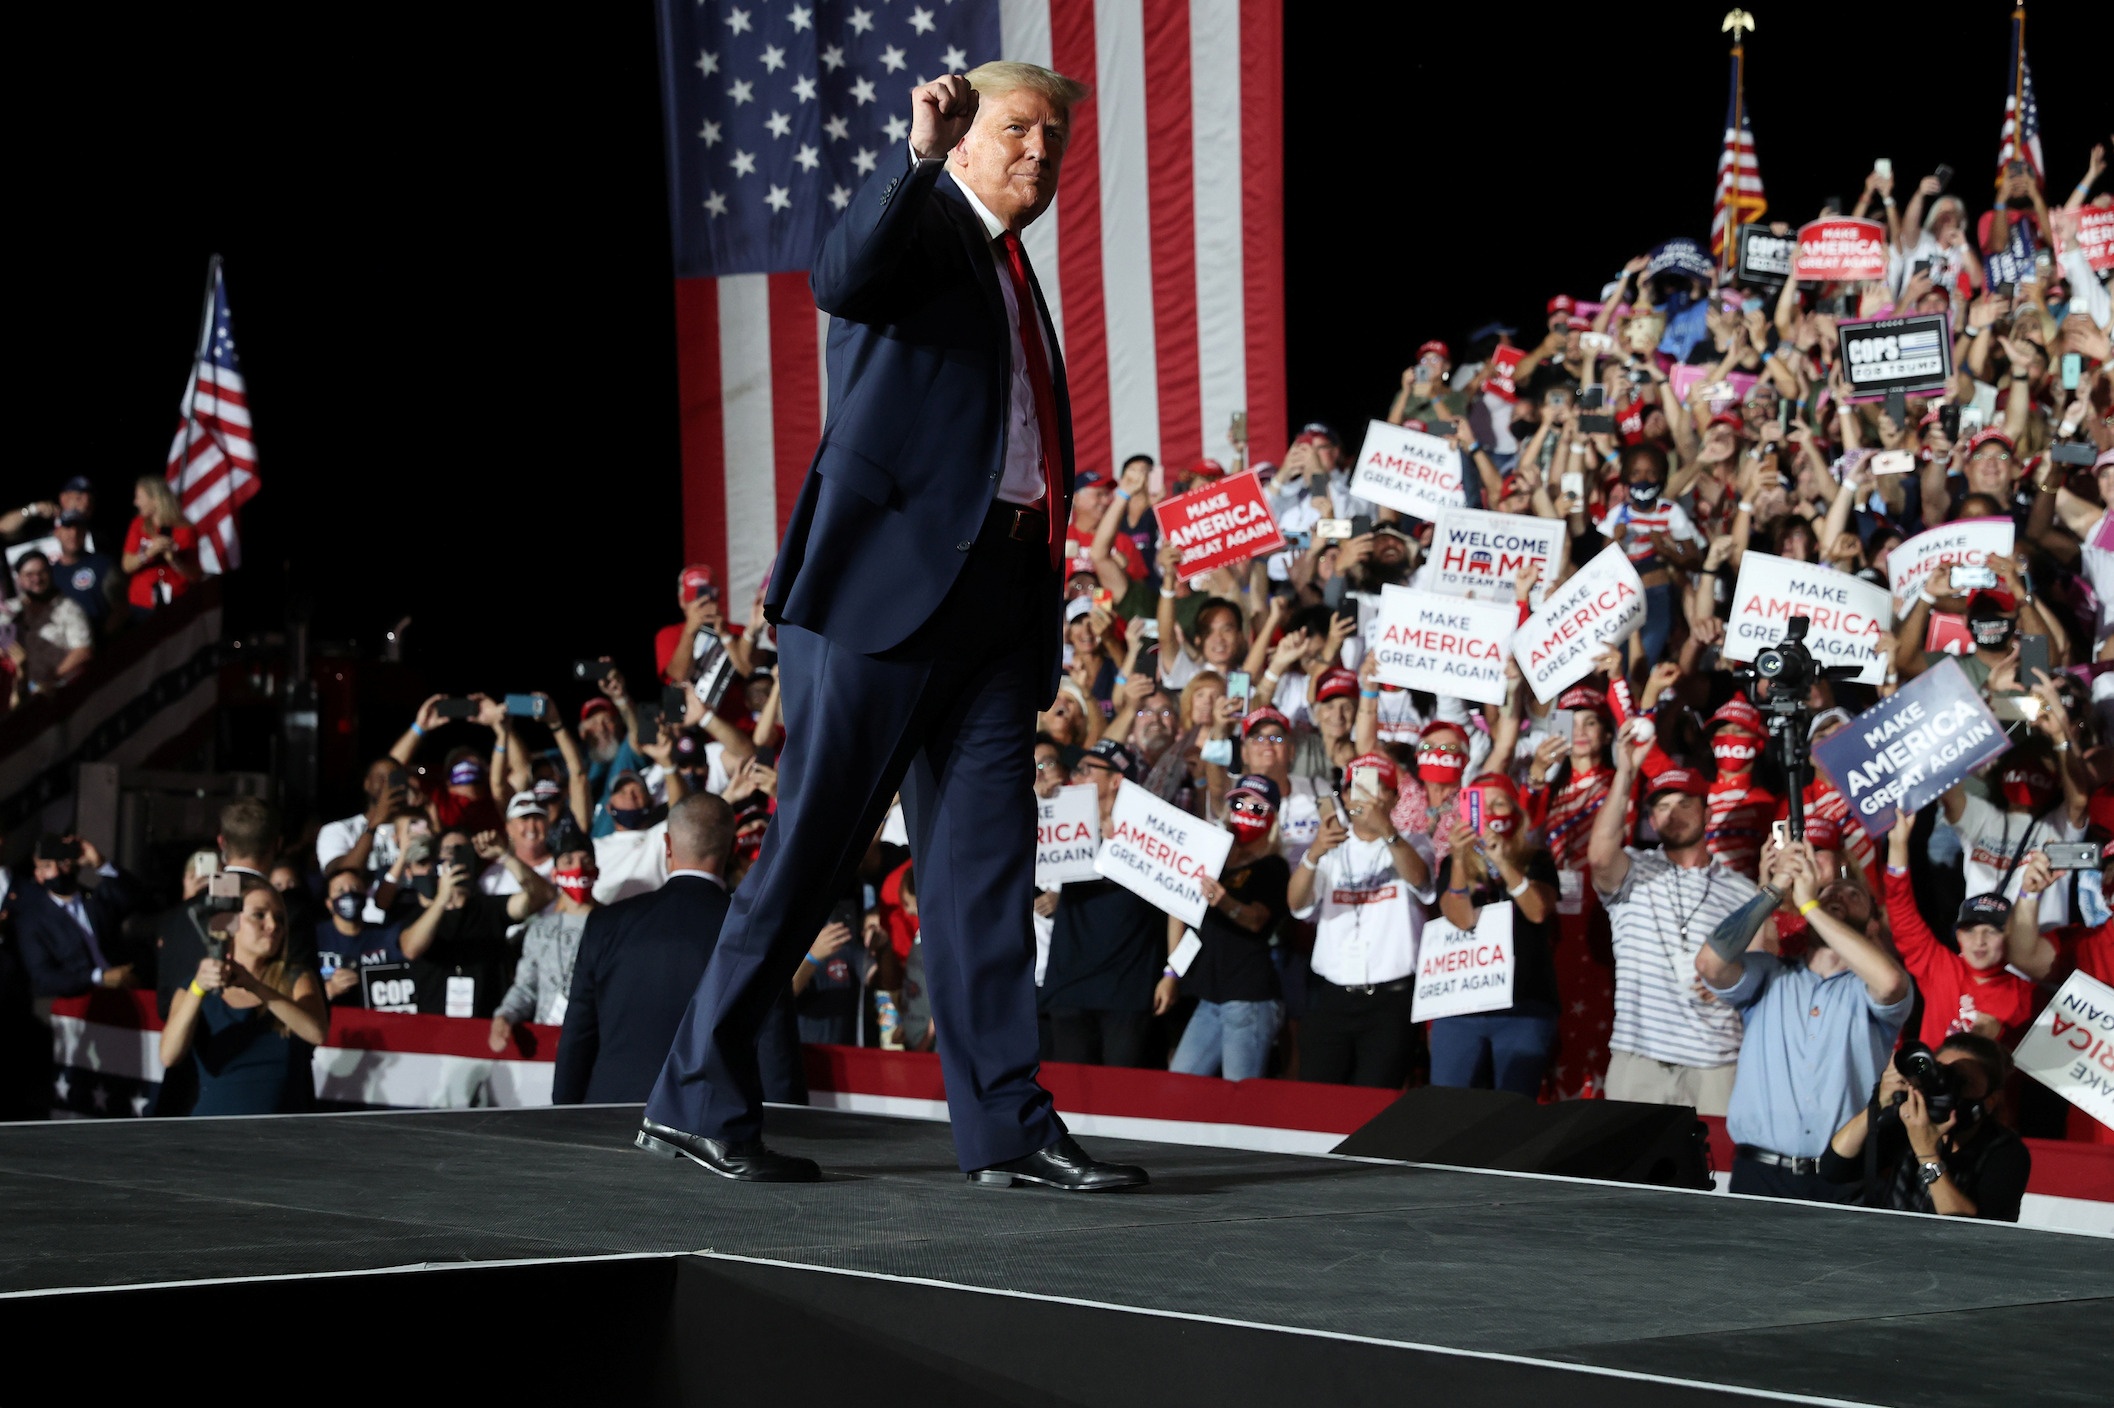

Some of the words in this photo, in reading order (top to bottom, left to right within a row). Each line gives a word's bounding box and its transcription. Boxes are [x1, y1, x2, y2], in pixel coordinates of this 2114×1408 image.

[1802, 239, 1882, 256] AMERICA
[1822, 227, 1860, 240] MAKE
[1798, 255, 1840, 269] GREAT
[1842, 254, 1884, 269] AGAIN
[1848, 335, 1899, 364] COPS
[1855, 367, 1882, 377] FOR
[1889, 361, 1938, 373] TRUMP
[1403, 444, 1446, 466] MAKE
[1363, 469, 1412, 493] GREAT
[1186, 492, 1231, 520] MAKE
[1170, 500, 1267, 548] AMERICA
[1226, 520, 1275, 548] AGAIN
[1449, 530, 1548, 554] WELCOME
[1918, 537, 1967, 555] MAKE
[1442, 573, 1458, 583] TO
[1461, 575, 1494, 586] TEAM
[1789, 580, 1848, 605] MAKE
[1419, 609, 1471, 631] MAKE
[1546, 585, 1591, 626] MAKE
[1530, 582, 1637, 669] AMERICA
[1738, 622, 1781, 643] GRE
[1813, 638, 1878, 661] AGAIN
[1383, 625, 1502, 662] AMERICA
[1536, 637, 1588, 682] GREAT
[1594, 602, 1642, 641] AGAIN
[1379, 650, 1438, 670] GREAT
[1442, 662, 1501, 683] AGAIN
[1863, 701, 1926, 749] MAKE
[1847, 699, 1980, 798] AMERICA
[1860, 765, 1926, 816] GREAT
[1929, 720, 1994, 774] AGAIN
[1146, 814, 1188, 846] MAKE
[1038, 847, 1094, 865] AGAIN
[1112, 821, 1208, 880] AMERICA
[1110, 843, 1152, 876] GREAT
[1155, 872, 1201, 905] AGAIN
[1423, 945, 1505, 977] AMERICA
[1419, 980, 1457, 999] GREAT
[1460, 973, 1506, 991] AGAIN
[2063, 993, 2114, 1031] GAIN
[2051, 1012, 2114, 1073] RICA
[2069, 1061, 2114, 1105] AKE
